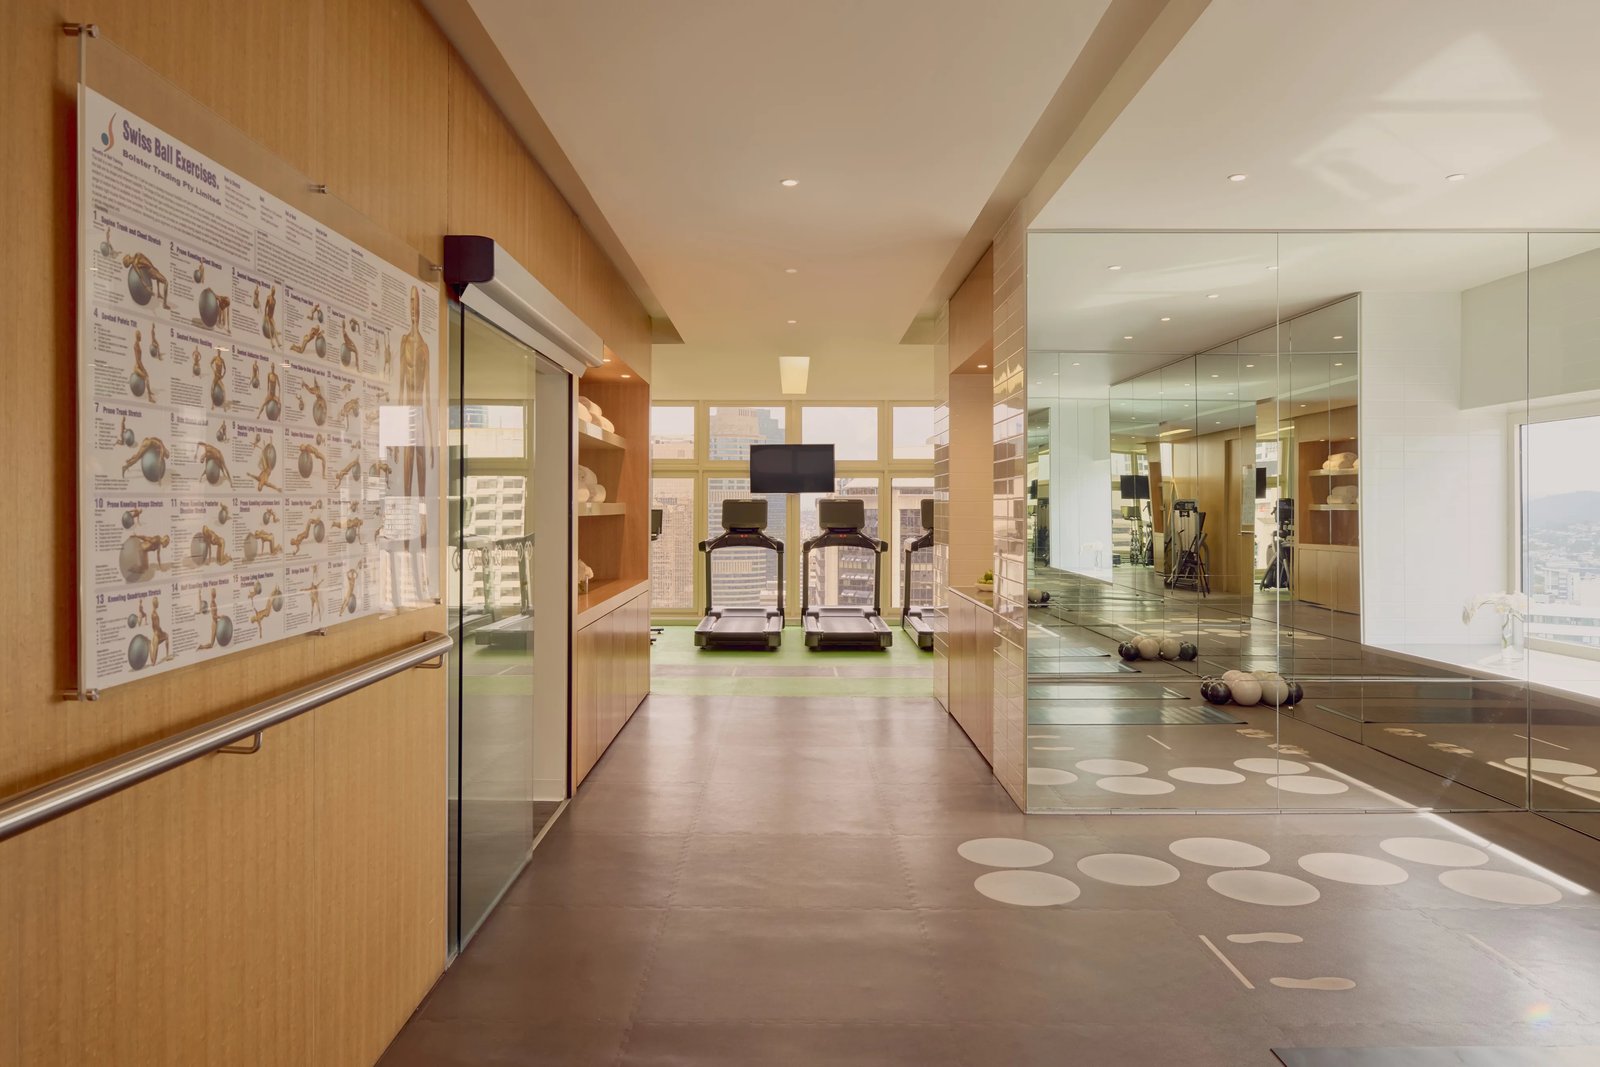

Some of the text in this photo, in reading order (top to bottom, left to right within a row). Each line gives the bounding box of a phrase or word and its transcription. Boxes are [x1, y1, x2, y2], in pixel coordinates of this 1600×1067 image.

[122, 119, 152, 153] Swiss
[155, 137, 173, 164] Ball
[122, 148, 151, 170] Bolster
[153, 165, 181, 187] Trading
[182, 180, 194, 193] Pty
[92, 210, 97, 220] 1
[169, 241, 174, 251] 2
[93, 307, 98, 318] 4
[170, 327, 175, 338] 5
[94, 402, 100, 412] 7
[128, 409, 142, 418] Stretch
[94, 497, 104, 508] 10
[170, 498, 178, 507] 11
[232, 497, 239, 507] 12
[171, 582, 179, 592] 14
[95, 594, 105, 605] 13
